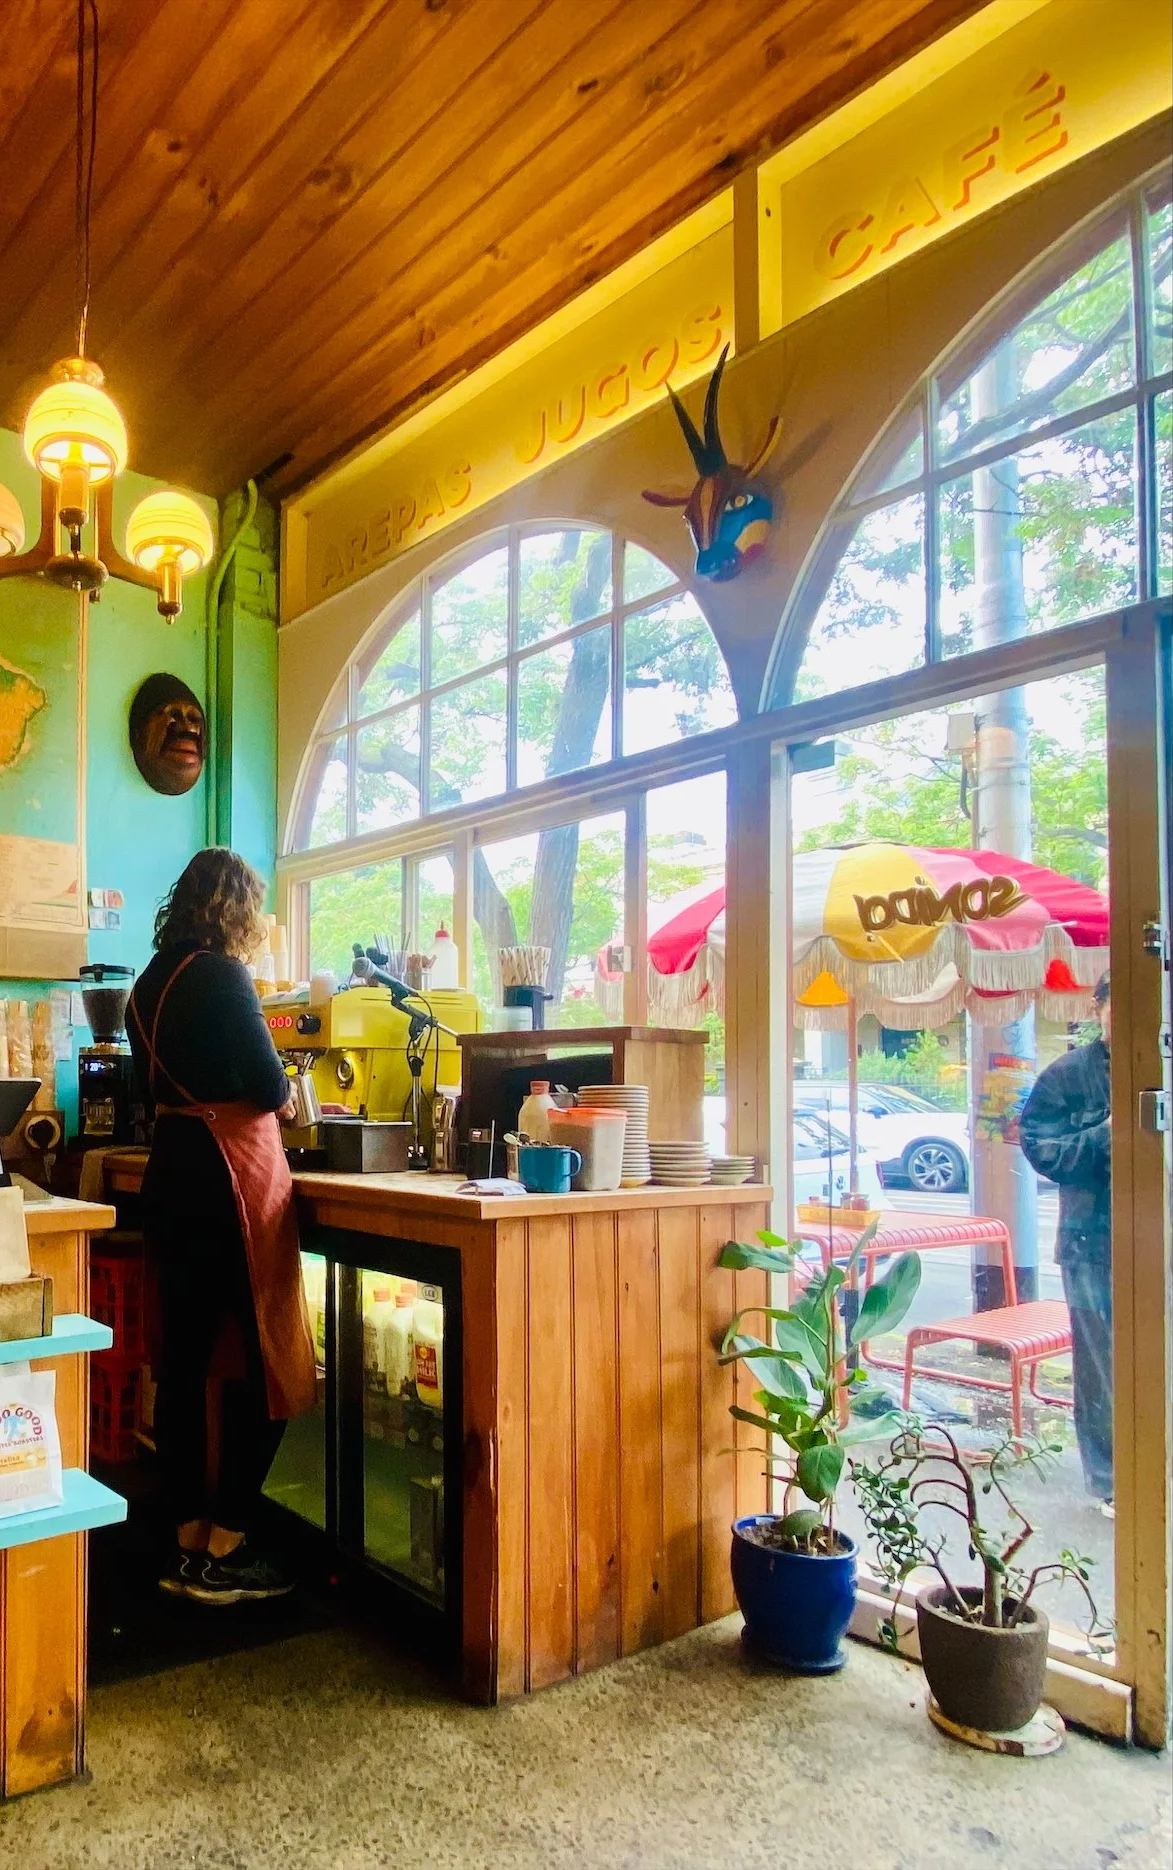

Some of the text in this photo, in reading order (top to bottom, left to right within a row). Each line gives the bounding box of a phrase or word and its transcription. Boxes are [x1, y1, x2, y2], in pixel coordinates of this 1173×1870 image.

[813, 69, 1068, 281] CAFÉ
[322, 303, 722, 587] AREPAS JUGOS
[15, 1407, 42, 1436] GOOD
